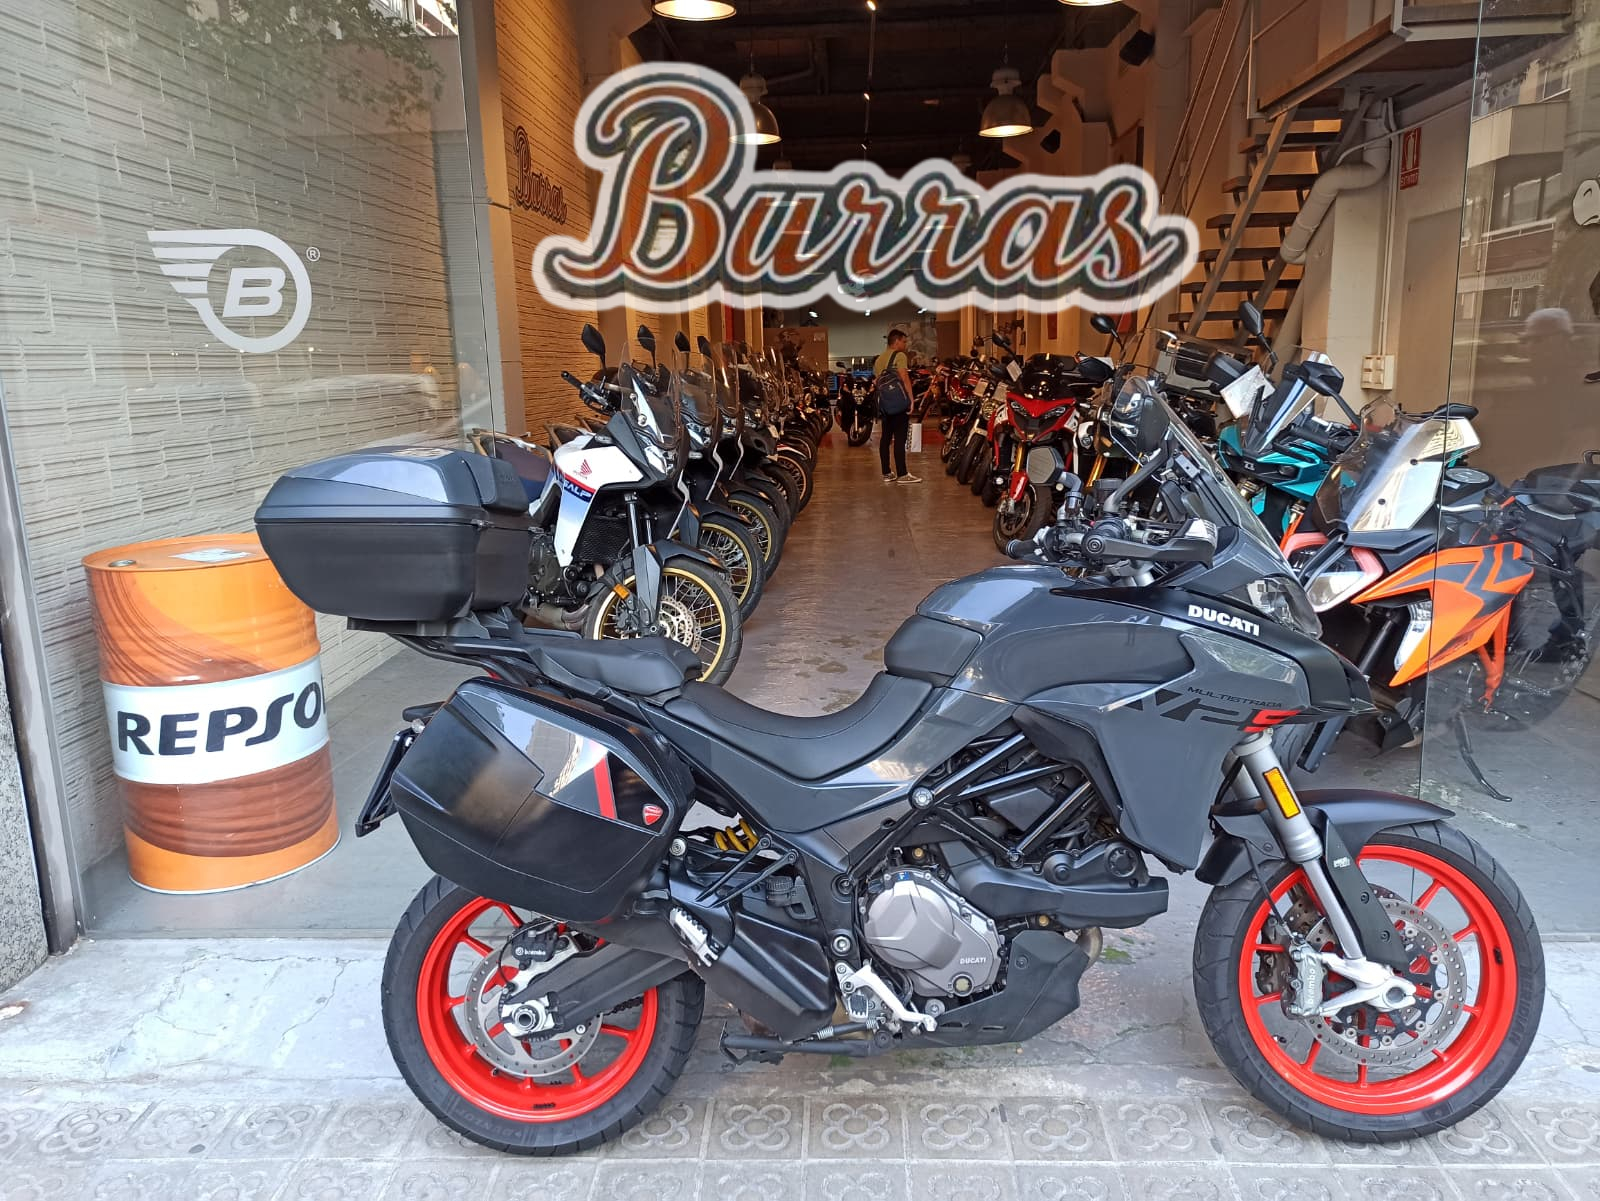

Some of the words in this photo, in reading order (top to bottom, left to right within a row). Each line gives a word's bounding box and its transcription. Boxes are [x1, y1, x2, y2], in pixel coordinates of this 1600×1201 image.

[1188, 604, 1260, 637] DUCATI
[1187, 686, 1282, 708] MULTISTRADA
[117, 673, 327, 757] REPSO
[960, 956, 987, 965] DUCATI
[1307, 968, 1316, 1005] brembo
